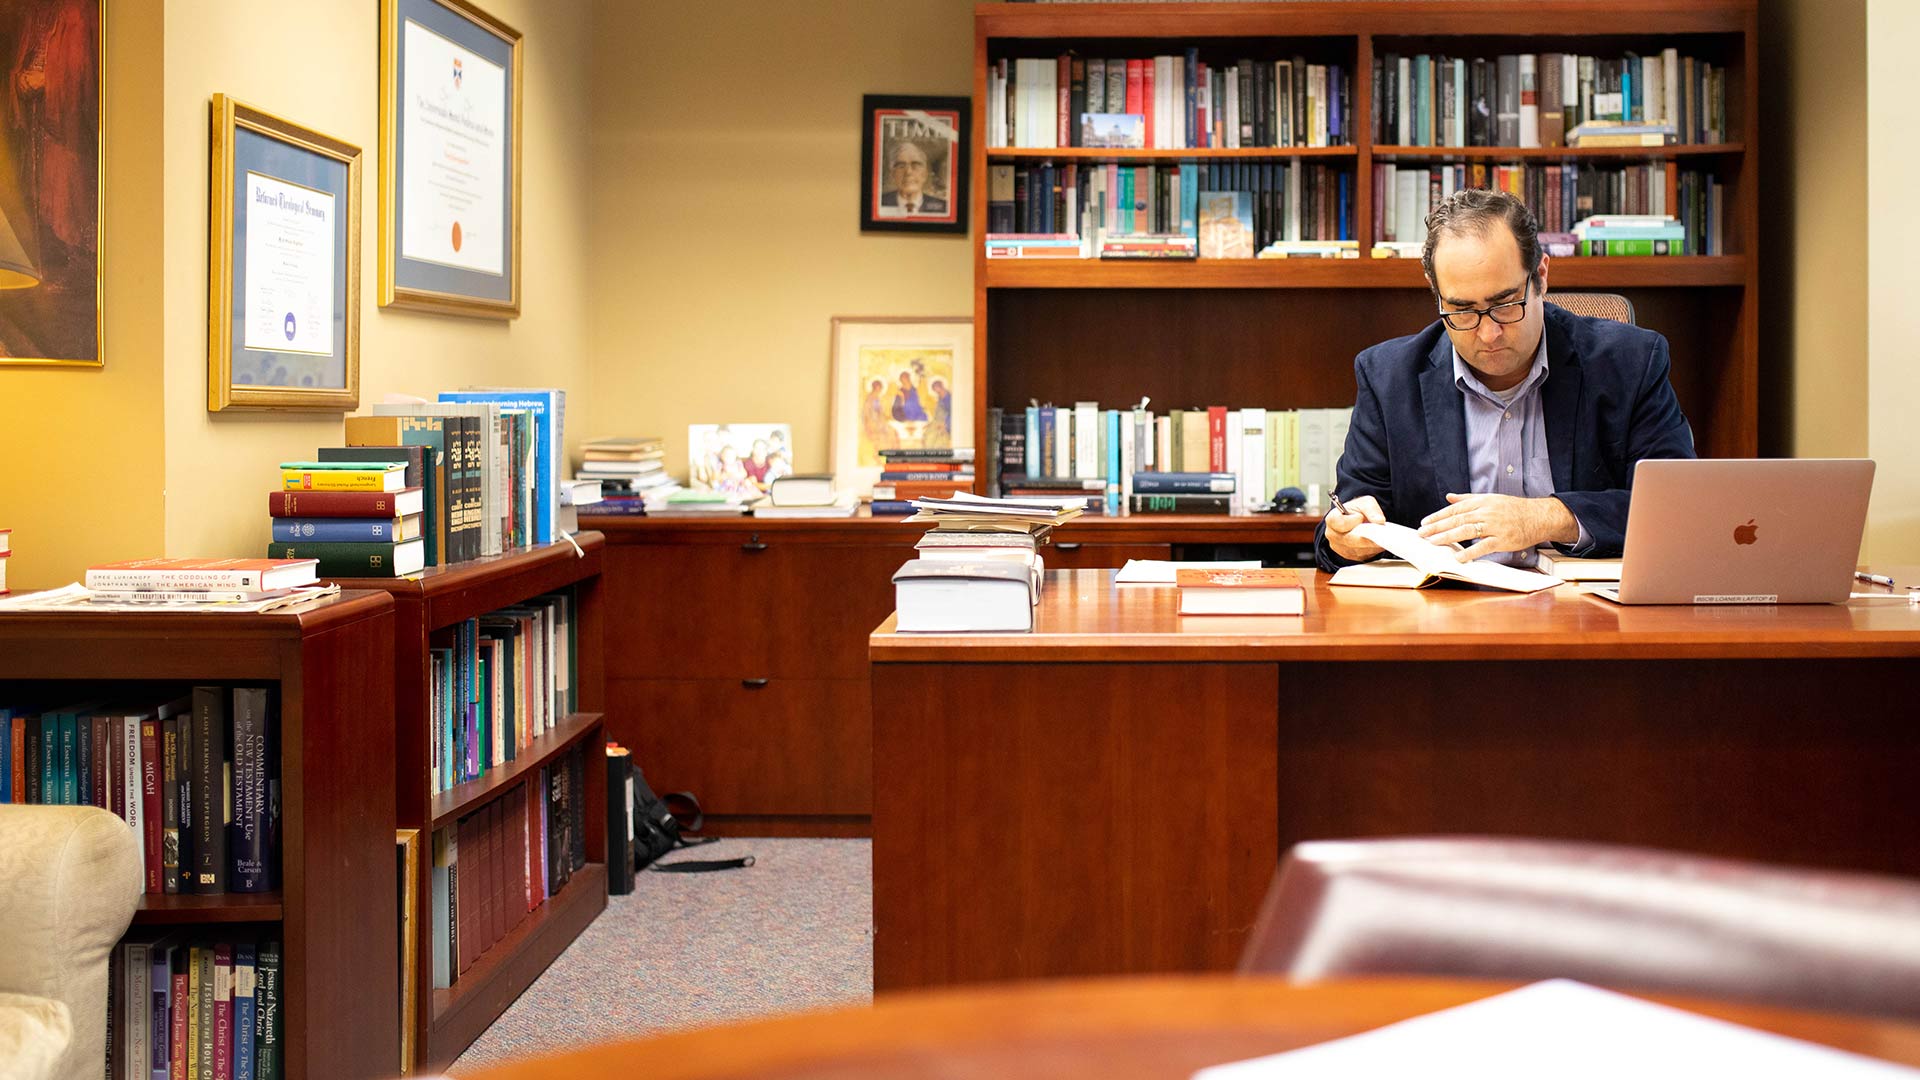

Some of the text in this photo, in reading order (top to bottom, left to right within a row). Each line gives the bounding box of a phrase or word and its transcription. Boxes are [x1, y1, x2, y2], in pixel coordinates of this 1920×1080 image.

[128, 724, 136, 765] FREEDOM
[245, 734, 254, 759] NEW
[80, 767, 88, 800] Theological
[145, 761, 154, 795] MICAH
[235, 721, 243, 829] of the OLD TESTAMENT
[255, 735, 265, 815] COMMENTARY
[245, 761, 254, 821] TESTAMENT
[245, 823, 254, 841] Use
[237, 858, 256, 867] Beale
[237, 867, 262, 875] Carson
[133, 975, 141, 999] Moral
[175, 977, 183, 991] The
[190, 987, 198, 1000] The
[203, 983, 213, 1009] JESUS
[133, 1001, 142, 1026] Vision
[174, 992, 183, 1022] Original
[190, 1003, 198, 1018] New
[218, 1003, 226, 1017] The
[241, 1002, 249, 1015] The
[256, 967, 266, 1036] Lord and Christ
[265, 967, 278, 1044] Jesus of Nazareth
[174, 1023, 182, 1041] Jesus
[190, 1023, 198, 1061] Testament
[217, 1019, 227, 1048] Christ
[241, 1017, 250, 1044] Christ
[133, 1038, 141, 1056] New
[174, 1042, 182, 1058] Tom
[203, 1043, 213, 1065] HOLY
[217, 1058, 226, 1071] The
[240, 1056, 248, 1070] The
